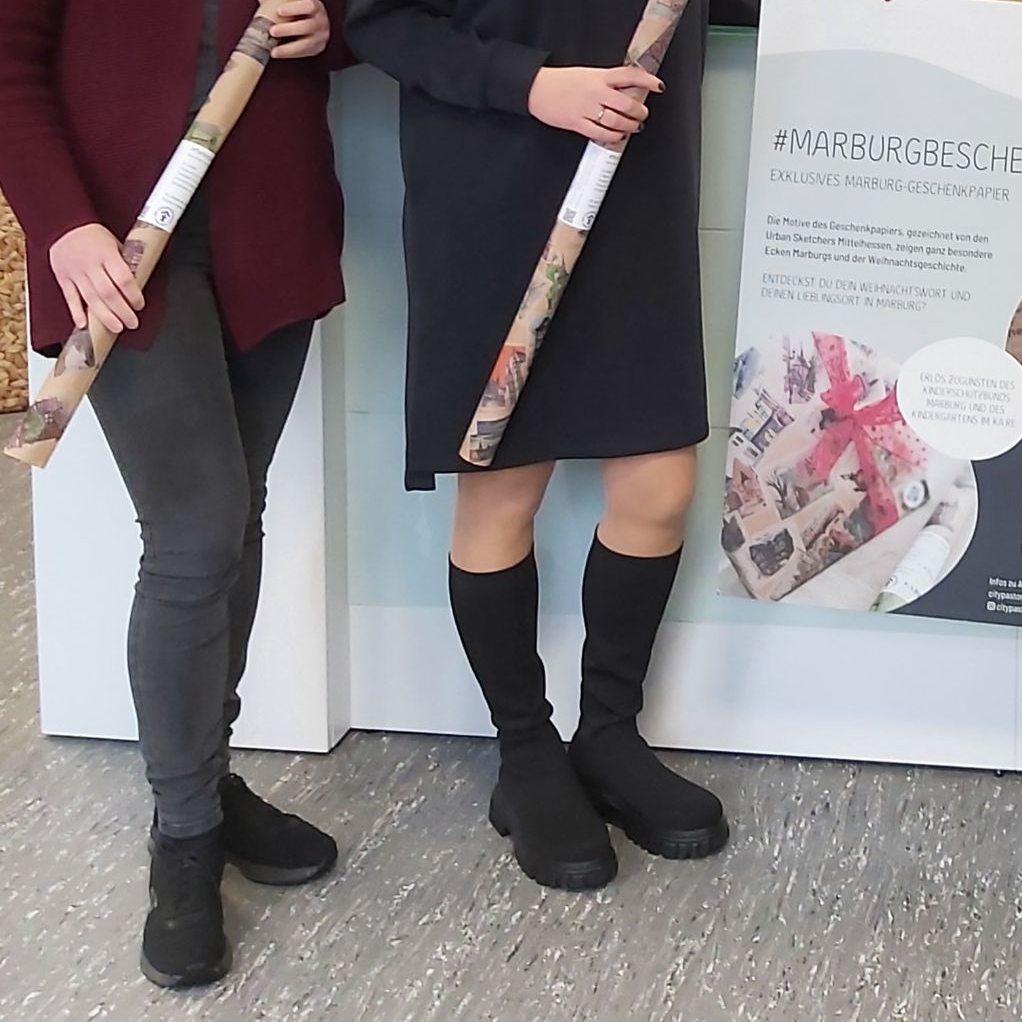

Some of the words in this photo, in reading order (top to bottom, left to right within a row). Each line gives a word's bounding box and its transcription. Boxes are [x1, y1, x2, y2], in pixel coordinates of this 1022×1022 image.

[844, 175, 1011, 201] MARBURG-GESCHENKPAPIER
[767, 215, 781, 226] Die
[782, 217, 810, 229] Motive
[812, 220, 828, 230] des
[906, 229, 954, 241] gezeichnet
[955, 233, 971, 242] von
[972, 234, 989, 244] den
[765, 231, 792, 242] Urban
[792, 233, 836, 246] Sketchers
[895, 243, 924, 255] zeigen
[925, 246, 946, 257] ganz
[947, 247, 993, 259] besondere
[764, 246, 791, 258] Ecken
[792, 248, 832, 263] Marburgs
[833, 252, 850, 262] und
[851, 254, 866, 264] der
[868, 255, 967, 273] Weihnachtsgeschichte.
[761, 287, 795, 300] DEINEN
[796, 290, 860, 307] LIEBLINGSORT
[863, 296, 874, 307] IN
[876, 298, 928, 312] MARBURG?
[762, 273, 815, 287] ENTDECKST
[818, 278, 833, 288] DU
[835, 279, 857, 291] DEIN
[859, 281, 947, 299] WEIHNACHTSWORT
[950, 290, 971, 301] UND
[948, 374, 998, 389] ZUGUNSTEN
[999, 379, 1016, 390] DES
[926, 397, 967, 411] MARBURG
[969, 402, 987, 413] UND
[989, 404, 1005, 415] DES
[989, 577, 1007, 587] Infos
[1008, 580, 1017, 588] zu
